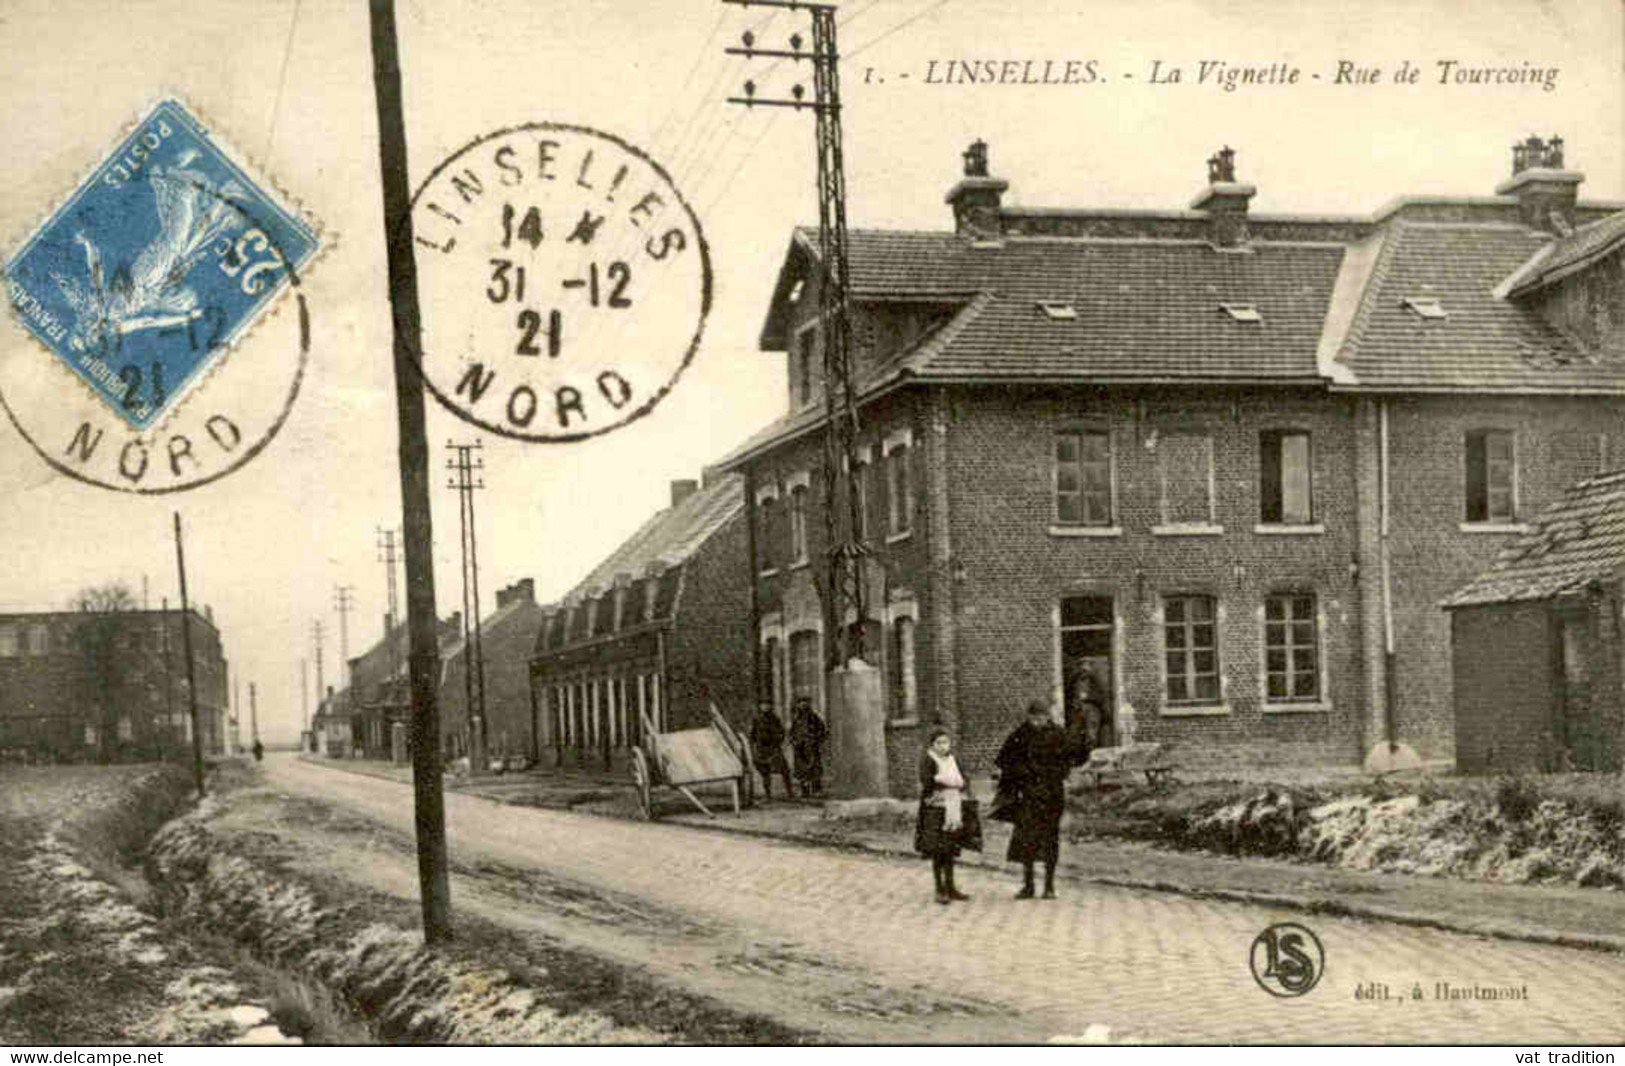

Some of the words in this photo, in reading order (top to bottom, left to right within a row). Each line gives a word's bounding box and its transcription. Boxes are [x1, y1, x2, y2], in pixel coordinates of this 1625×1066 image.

[103, 119, 172, 186] POSTES
[487, 259, 525, 304] 31
[516, 309, 561, 358] 21
[119, 361, 165, 410] 21
[456, 362, 632, 428] NORD
[66, 420, 242, 483] NORD
